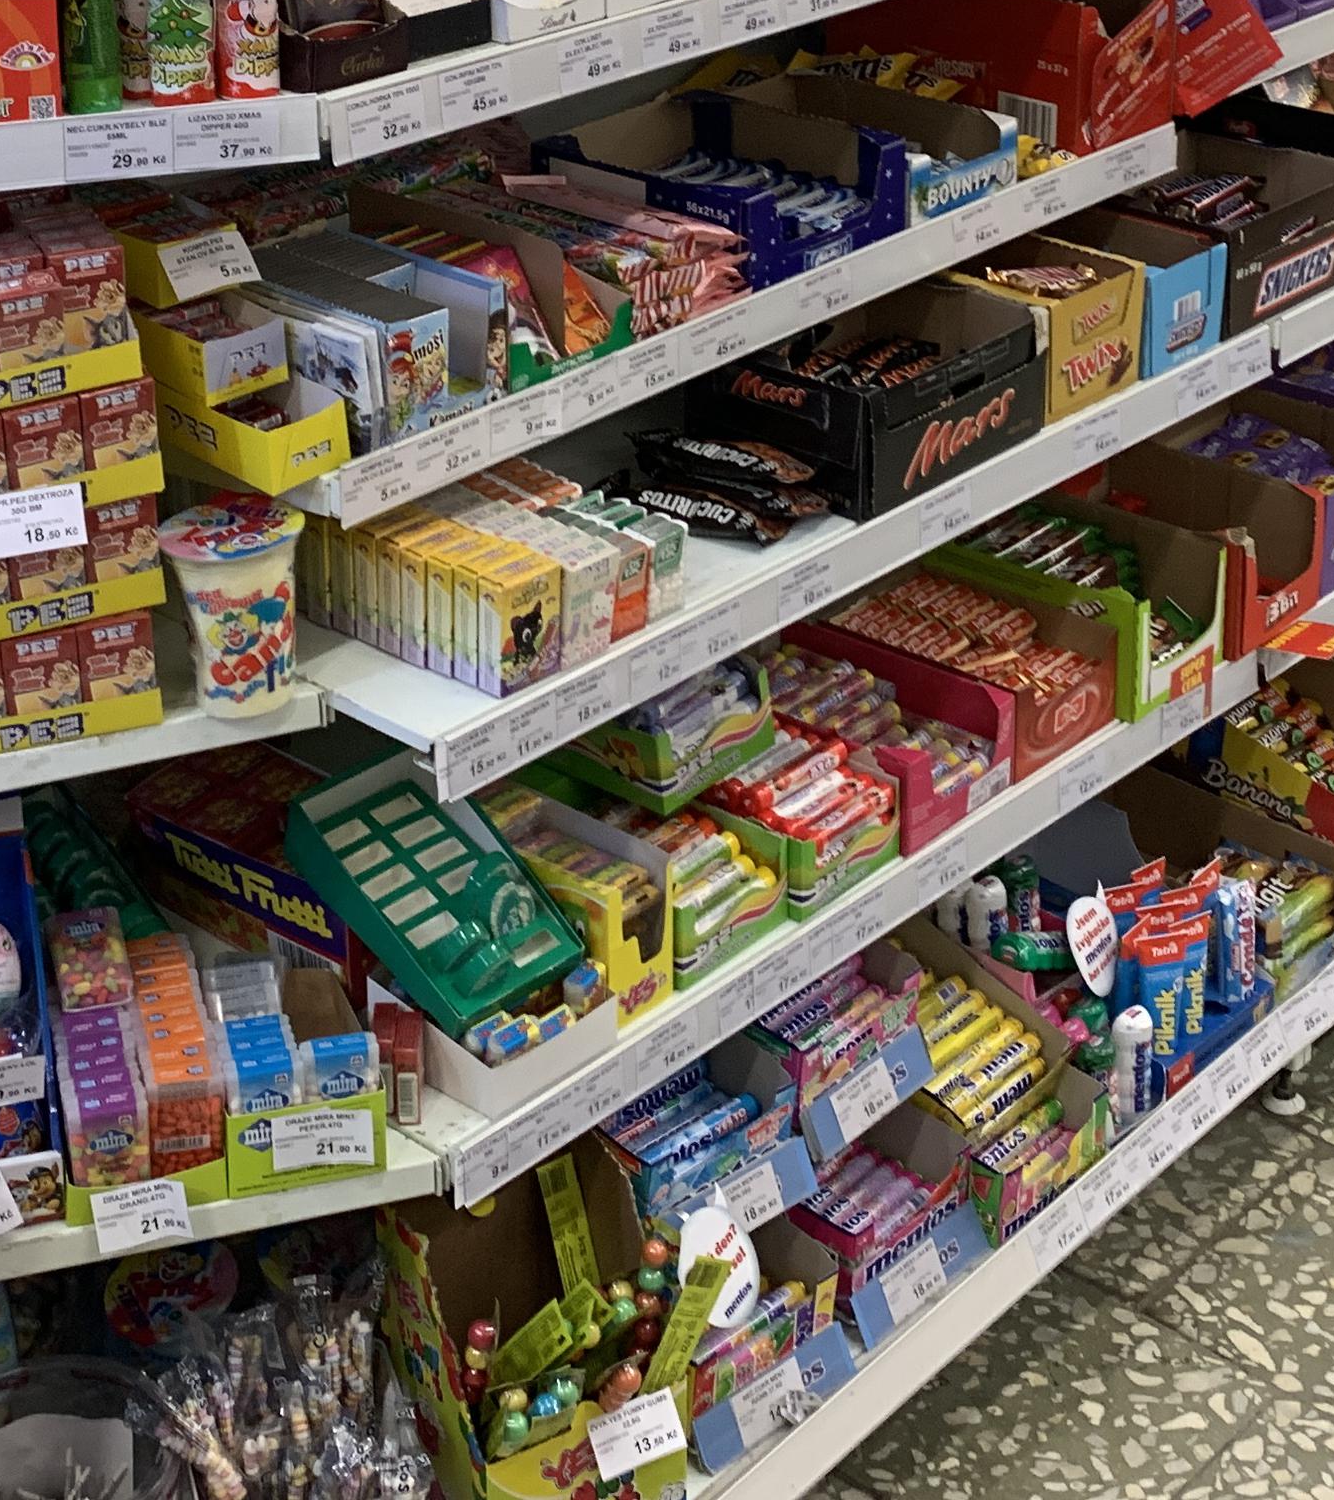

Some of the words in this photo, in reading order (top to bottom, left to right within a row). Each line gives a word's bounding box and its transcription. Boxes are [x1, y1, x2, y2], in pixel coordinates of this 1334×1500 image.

[153, 64, 207, 89] Dipper
[112, 154, 149, 169] 29,90
[219, 144, 255, 159] 37,90
[926, 169, 997, 209] BOUNTY
[64, 254, 108, 273] PEZ
[1, 296, 45, 315] PEZ
[1065, 337, 1122, 391] Twix
[97, 388, 139, 408] PEZ
[732, 370, 805, 406] Mars
[17, 407, 62, 427] PEZ
[904, 389, 1014, 490] Mars
[24, 526, 62, 545] 18,50
[65, 525, 79, 536] Kč
[8, 591, 94, 633] PEZ
[1202, 759, 1292, 819] Banana
[168, 835, 234, 895] Tutti
[235, 871, 332, 937] Frutti
[1074, 907, 1097, 931] Jsem
[325, 1076, 362, 1095] mira
[95, 1132, 127, 1151] mira
[867, 1190, 958, 1282] mentos
[724, 1280, 753, 1319] mentos
